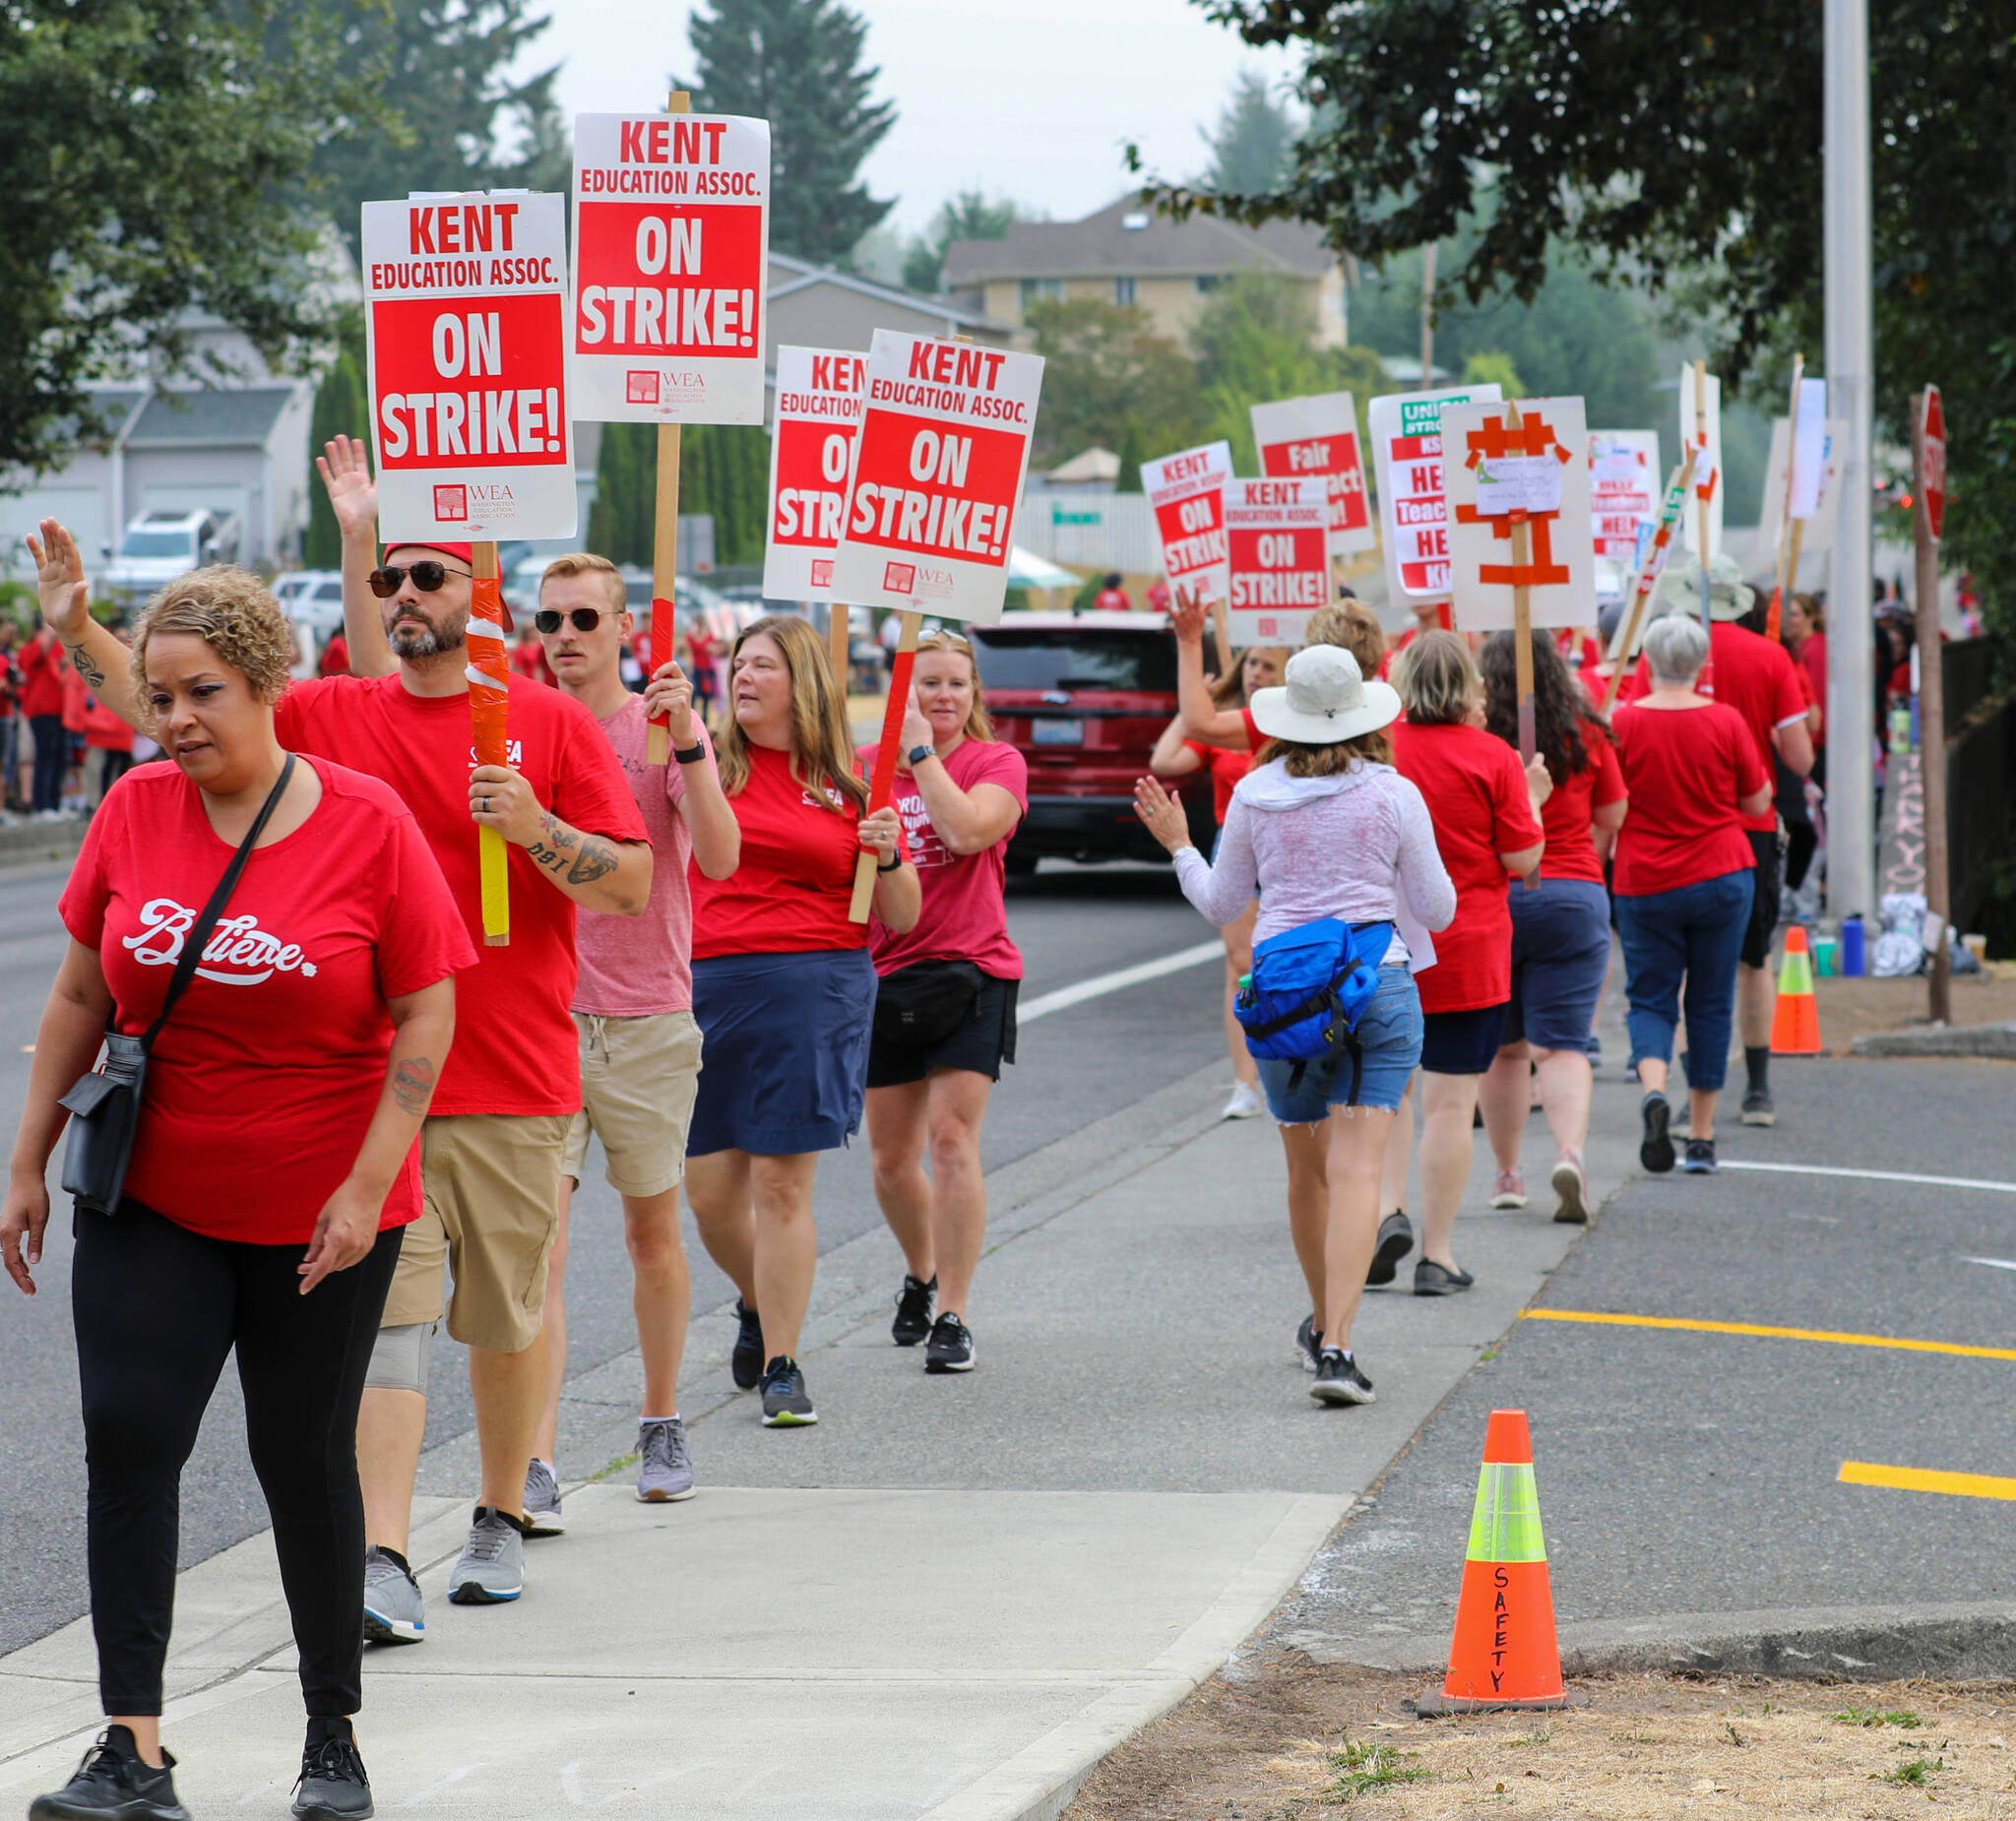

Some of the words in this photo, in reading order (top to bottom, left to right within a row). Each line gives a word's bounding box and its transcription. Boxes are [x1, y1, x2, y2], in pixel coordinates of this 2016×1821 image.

[620, 120, 726, 165] KENT
[581, 169, 688, 195] EDUCATION
[695, 171, 761, 197] ASSOC.
[409, 203, 519, 255] KENT
[635, 216, 703, 276] ON
[372, 259, 482, 290] EDUCATION
[489, 257, 558, 285] ASSOC.
[581, 285, 754, 347] STRIKE!
[432, 311, 502, 379] ON
[909, 341, 1005, 392] KENT
[662, 372, 705, 387] WEA
[870, 378, 966, 413] EDUCATION
[971, 396, 1029, 424] ASSOC.
[381, 387, 561, 459] STRIKE!
[910, 429, 973, 488] ON
[1162, 451, 1209, 483] KENT
[1288, 441, 1330, 471] Fair
[470, 484, 513, 500] WEA
[1245, 482, 1301, 505] KENT
[851, 482, 1009, 557] STRIKE!
[1179, 496, 1216, 534] ON
[1257, 534, 1296, 569] ON
[1231, 570, 1326, 606] STRIKE!
[1490, 1567, 1510, 1693] SAFETY
